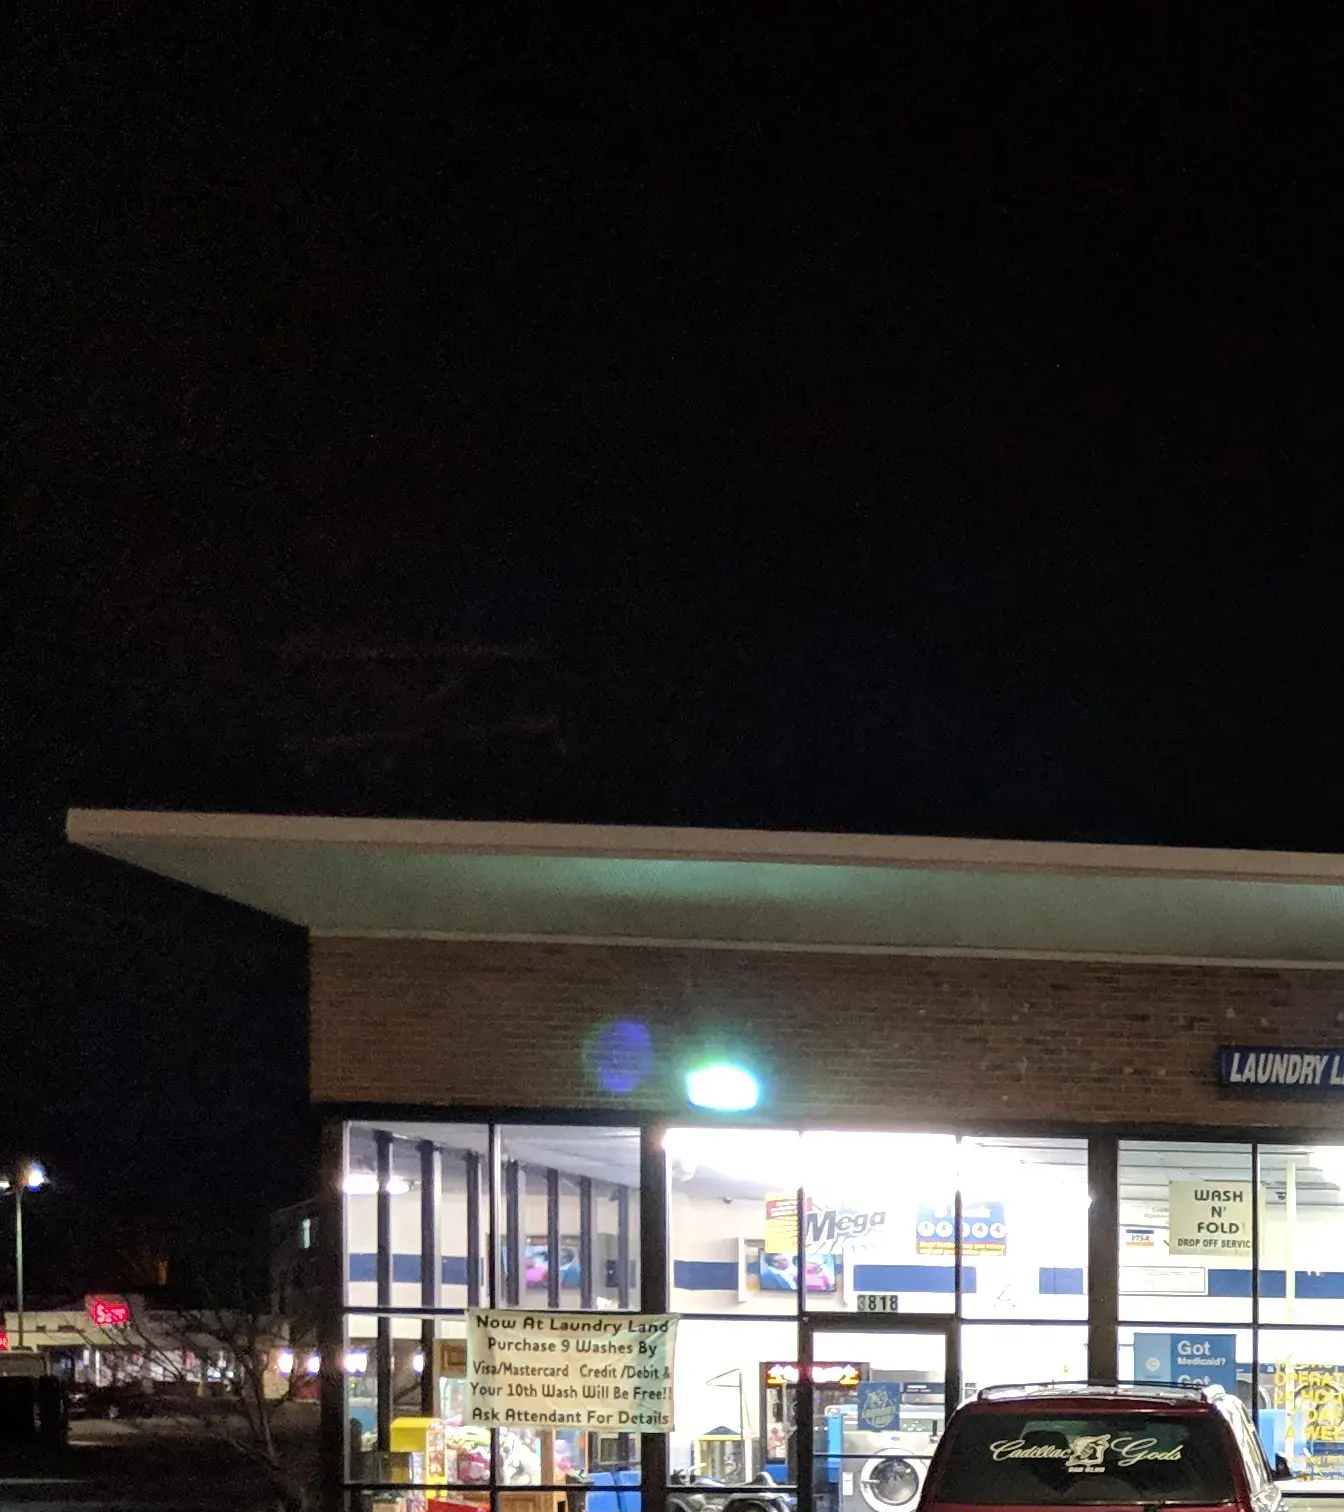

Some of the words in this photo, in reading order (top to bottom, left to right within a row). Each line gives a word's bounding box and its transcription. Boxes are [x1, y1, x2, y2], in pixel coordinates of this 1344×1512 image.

[1230, 1052, 1329, 1085] LAUNDRY
[1194, 1189, 1243, 1202] WASH
[806, 1209, 887, 1243] Mega
[1177, 1238, 1200, 1247] DROP
[1203, 1239, 1218, 1248] OFF
[1221, 1239, 1252, 1249] SERVIC
[476, 1315, 516, 1329] Now
[523, 1317, 544, 1330] At
[550, 1318, 622, 1335] Laundry
[628, 1320, 669, 1333] Land
[488, 1337, 556, 1353] Purchase
[561, 1340, 570, 1352] 9
[576, 1340, 633, 1354] Washes
[638, 1341, 658, 1357] By
[1177, 1340, 1212, 1356] Got
[473, 1360, 569, 1378] Visa/Mastercard
[579, 1364, 617, 1378] Credit
[620, 1365, 660, 1379] /Debit
[662, 1369, 671, 1379] &
[1177, 1357, 1226, 1366] Medicaid?
[470, 1382, 503, 1396] Your
[507, 1384, 538, 1397] 10th
[542, 1384, 577, 1399] Wash
[582, 1384, 609, 1399] Will
[614, 1386, 629, 1400] Be
[472, 1407, 500, 1421] Ask
[505, 1408, 582, 1424] Attendant
[587, 1410, 613, 1424] For
[619, 1410, 669, 1425] Details
[990, 1439, 1072, 1461] Cadillac
[1111, 1437, 1184, 1467] Gods
